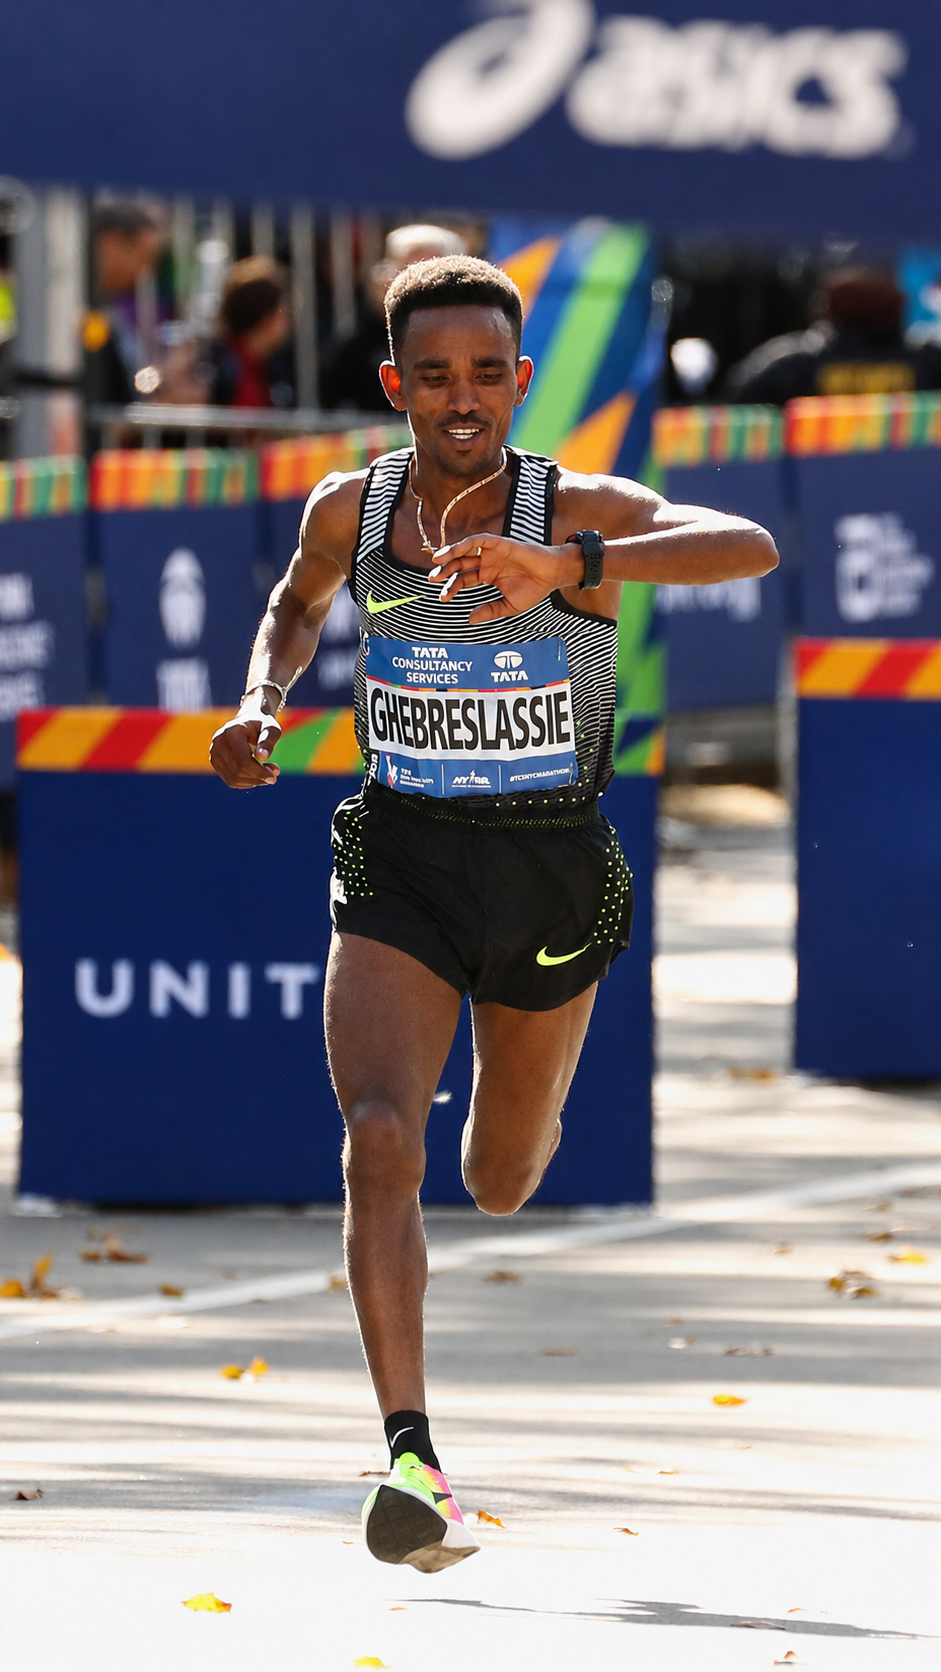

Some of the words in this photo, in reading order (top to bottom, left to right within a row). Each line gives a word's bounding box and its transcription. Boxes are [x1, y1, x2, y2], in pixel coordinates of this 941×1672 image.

[411, 646, 449, 659] TATA
[392, 656, 473, 672] CONSULTANCY
[406, 671, 459, 684] SERVICES
[491, 670, 529, 683] TATA
[370, 687, 571, 751] GHEBRESLASSIE
